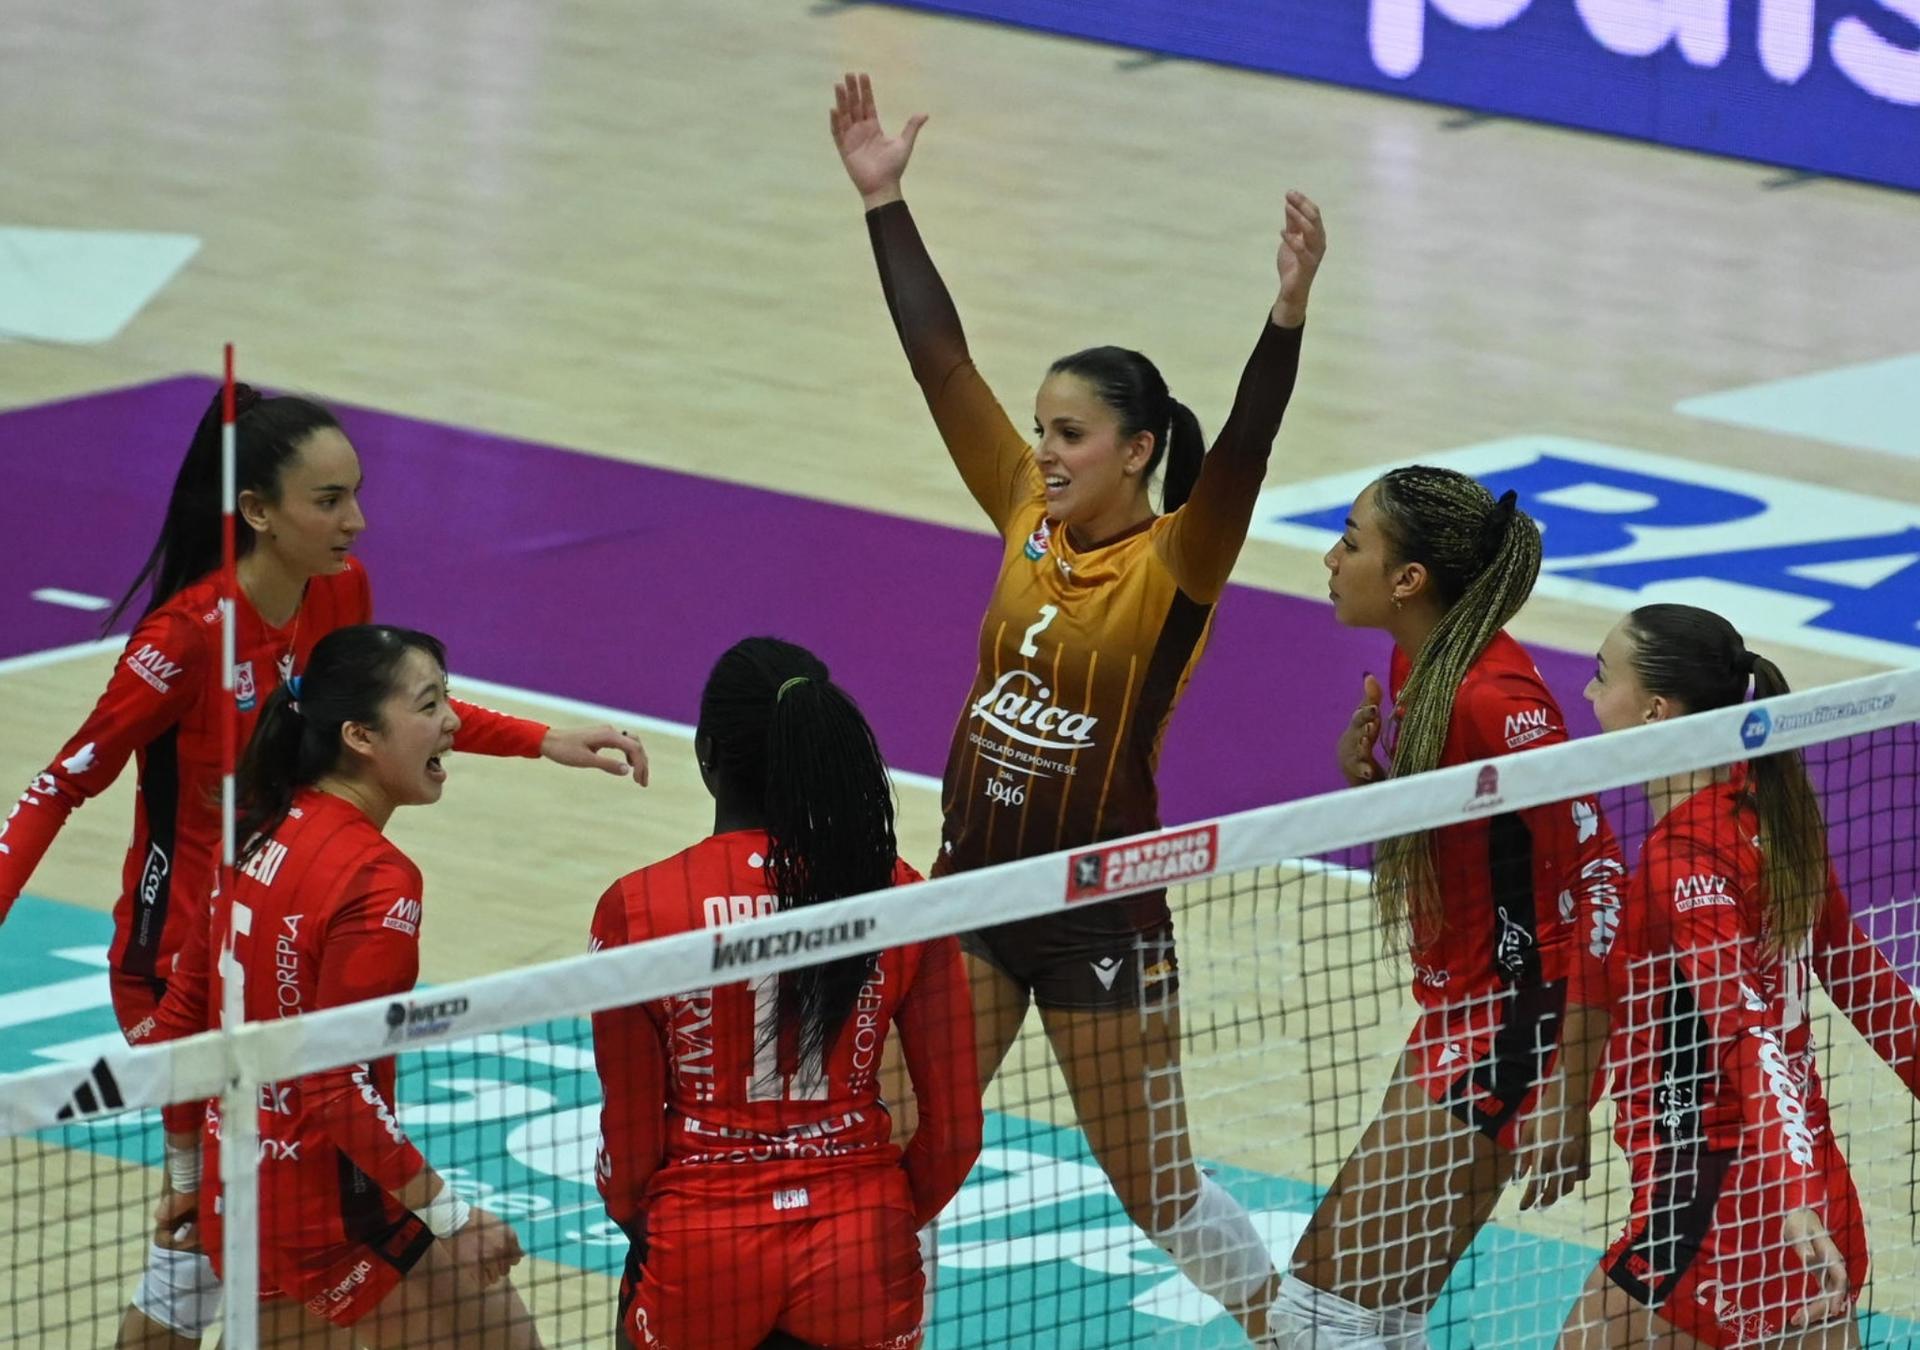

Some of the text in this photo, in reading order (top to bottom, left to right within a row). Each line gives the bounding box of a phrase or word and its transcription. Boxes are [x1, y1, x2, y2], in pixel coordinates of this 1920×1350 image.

[1019, 603, 1059, 658] 2
[134, 643, 183, 680] MW
[971, 669, 1099, 749] Laica
[1504, 707, 1548, 739] MW
[1014, 750, 1078, 776] PIEMONTESE
[984, 776, 1026, 807] 1946
[1106, 831, 1211, 868] ANTONIO
[1104, 848, 1210, 890] CARRARO
[1674, 873, 1728, 902] MW
